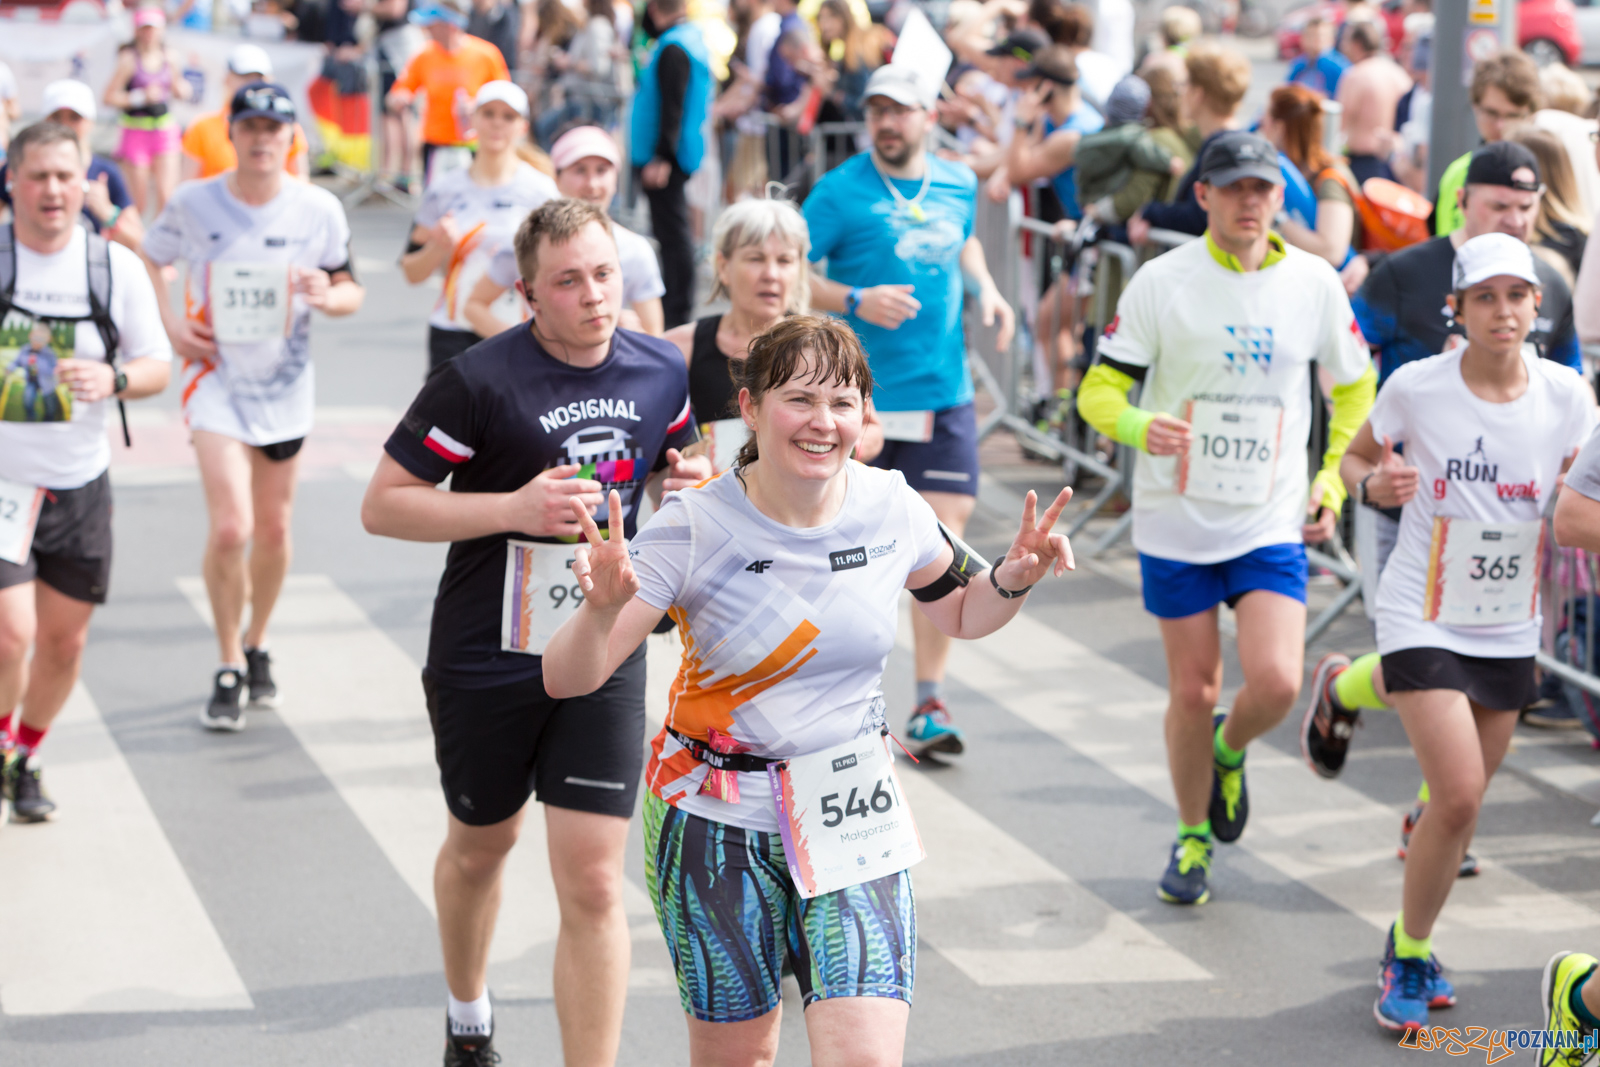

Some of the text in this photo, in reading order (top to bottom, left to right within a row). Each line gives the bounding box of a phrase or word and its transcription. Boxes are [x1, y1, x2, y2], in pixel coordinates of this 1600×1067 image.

[539, 398, 641, 434] NOSIGNAL
[1200, 434, 1271, 462] 10176
[1446, 458, 1498, 482] RUN
[834, 551, 865, 566] 11.PKO
[1469, 554, 1521, 580] 365
